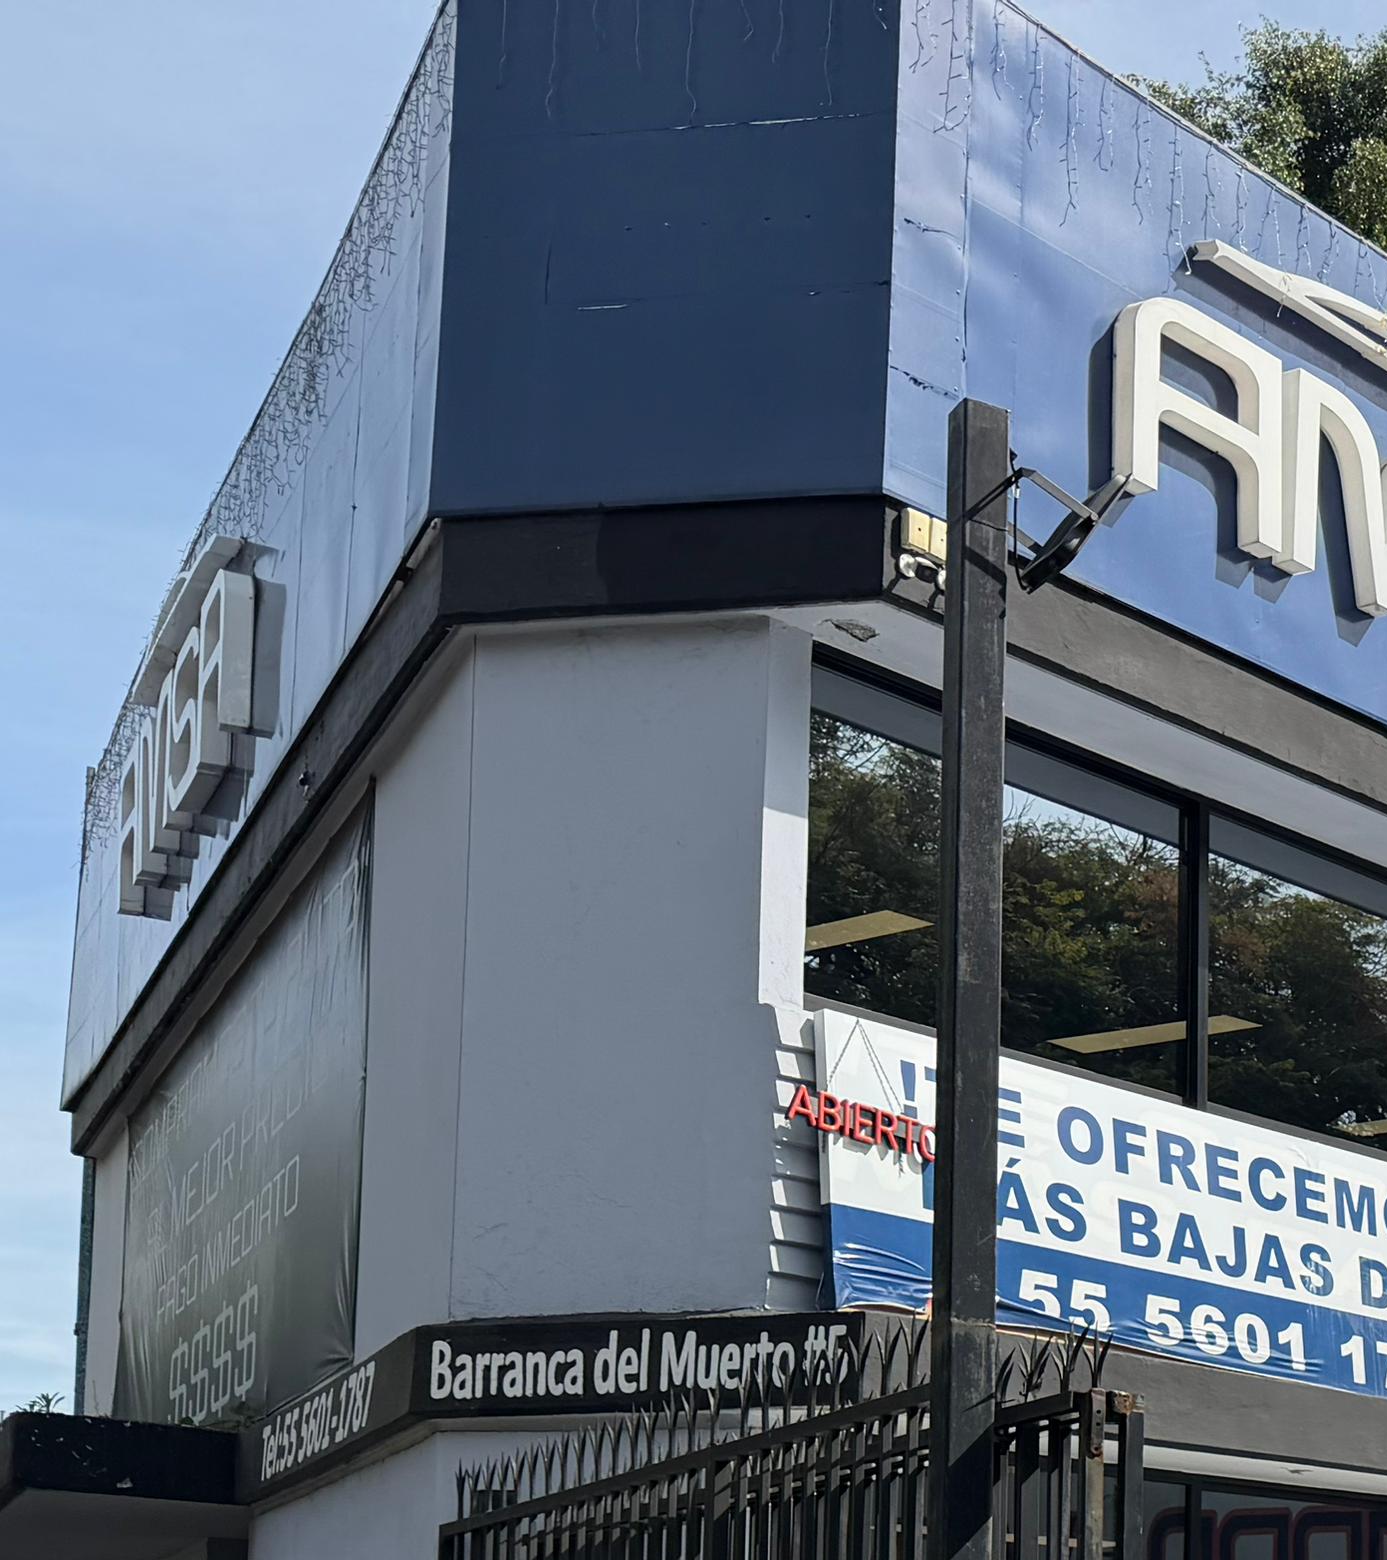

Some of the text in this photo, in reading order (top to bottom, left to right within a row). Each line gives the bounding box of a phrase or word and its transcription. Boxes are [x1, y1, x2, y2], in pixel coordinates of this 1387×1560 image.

[785, 1084, 935, 1162] ABIERTO
[201, 1154, 300, 1294] INMEDIATO
[1118, 1198, 1334, 1297] BAJAS
[430, 1339, 584, 1399] Barranca
[594, 1328, 650, 1394] del
[660, 1330, 795, 1392] Muerto
[1018, 1269, 1112, 1333] 55
[1144, 1294, 1307, 1372] 5601
[297, 1361, 376, 1464] 5601-1787
